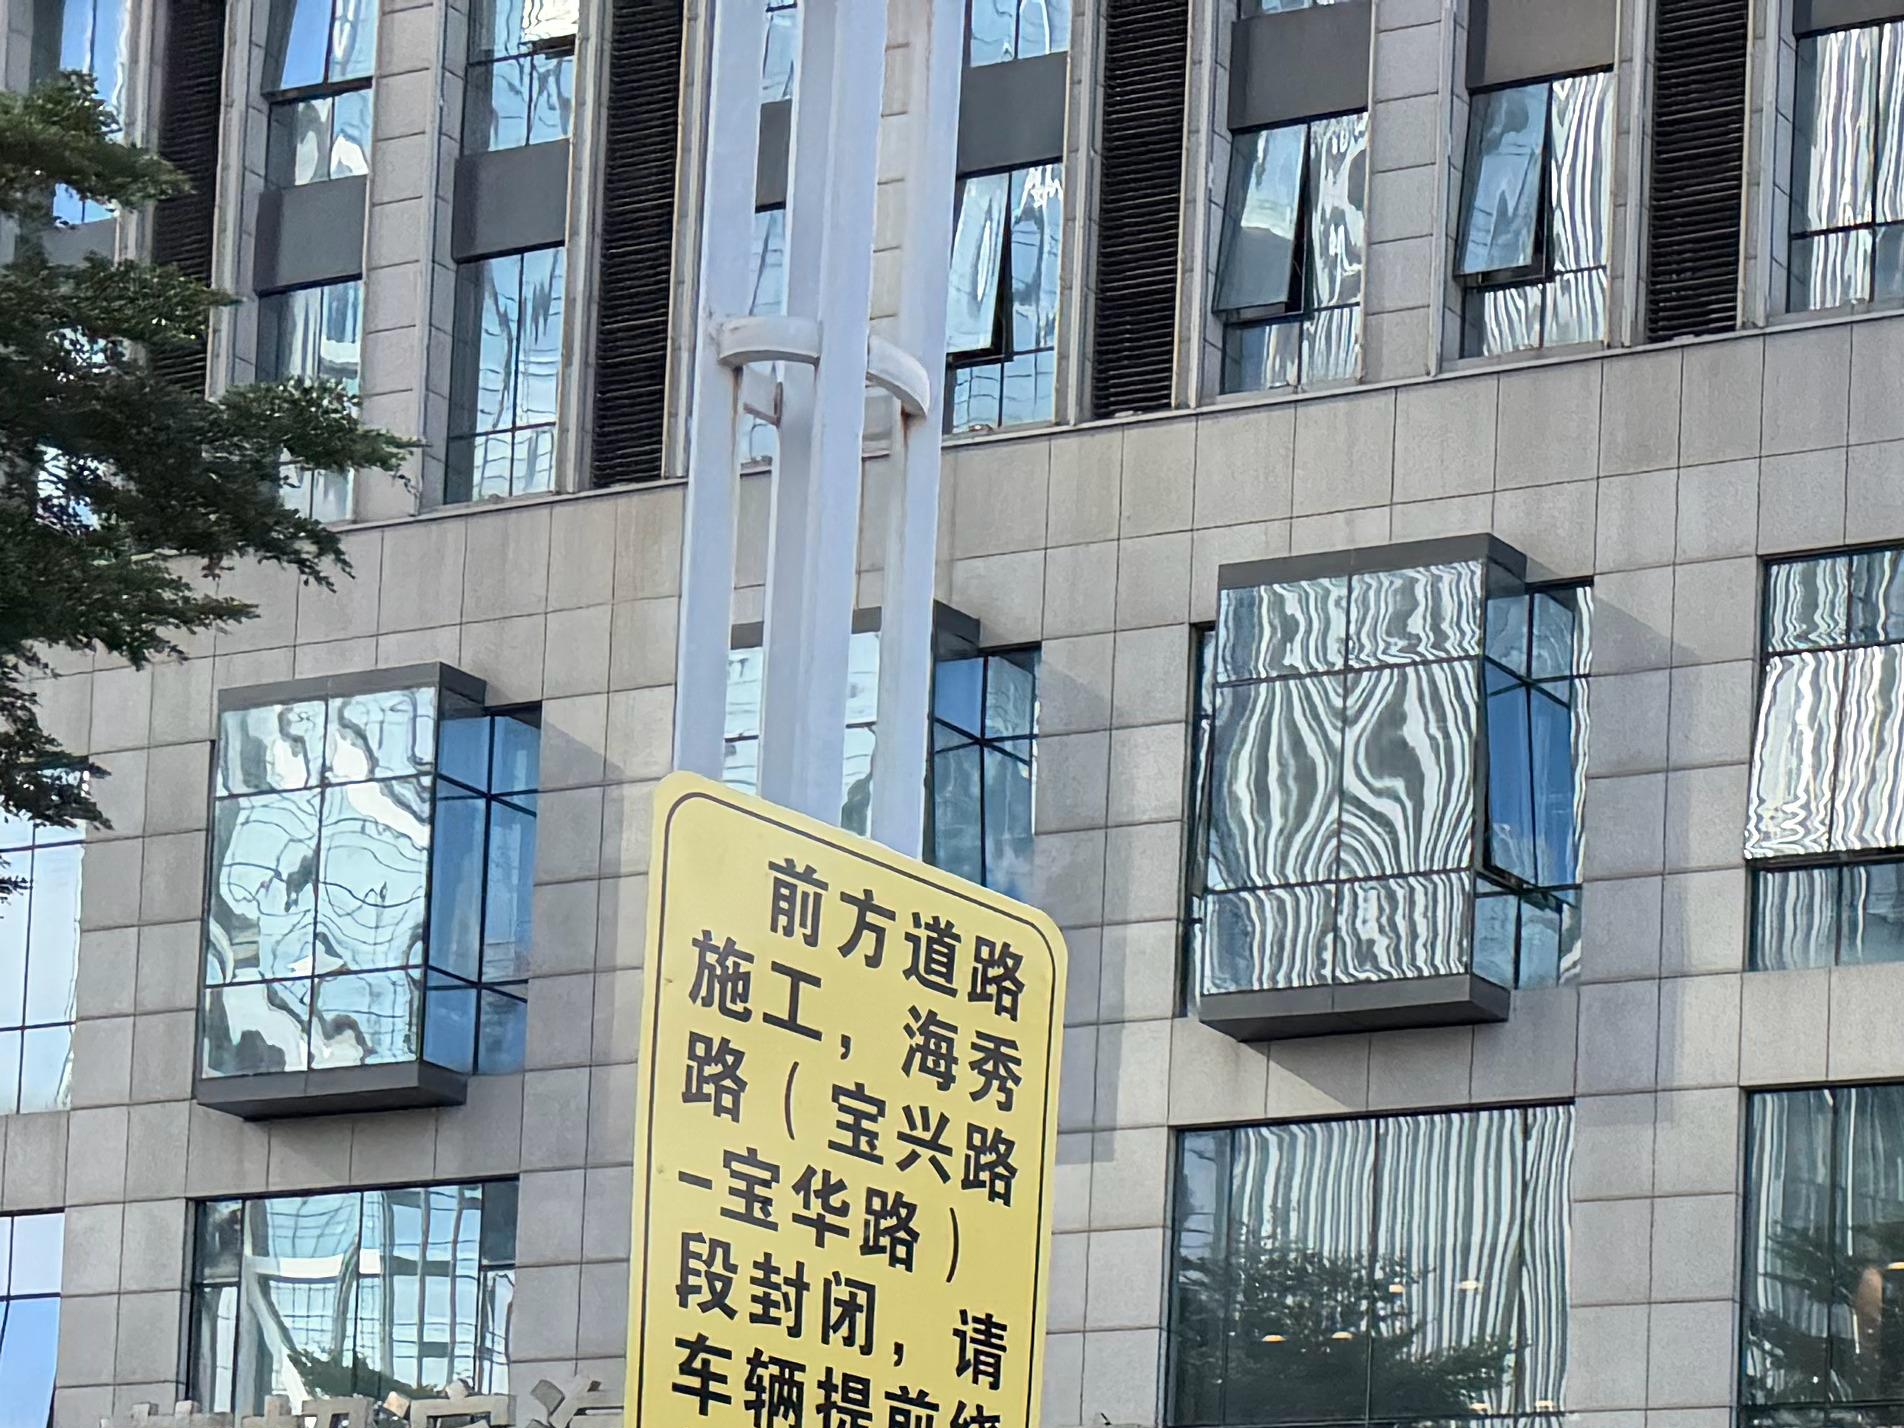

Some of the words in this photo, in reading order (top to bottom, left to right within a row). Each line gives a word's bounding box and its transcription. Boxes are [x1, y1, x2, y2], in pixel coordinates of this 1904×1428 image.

[688, 929, 1023, 1114] 施工，海秀
[767, 857, 1027, 1024] 前方道路
[682, 1031, 1019, 1208] 路（宝兴路
[675, 1231, 1009, 1393] 段封闭，请
